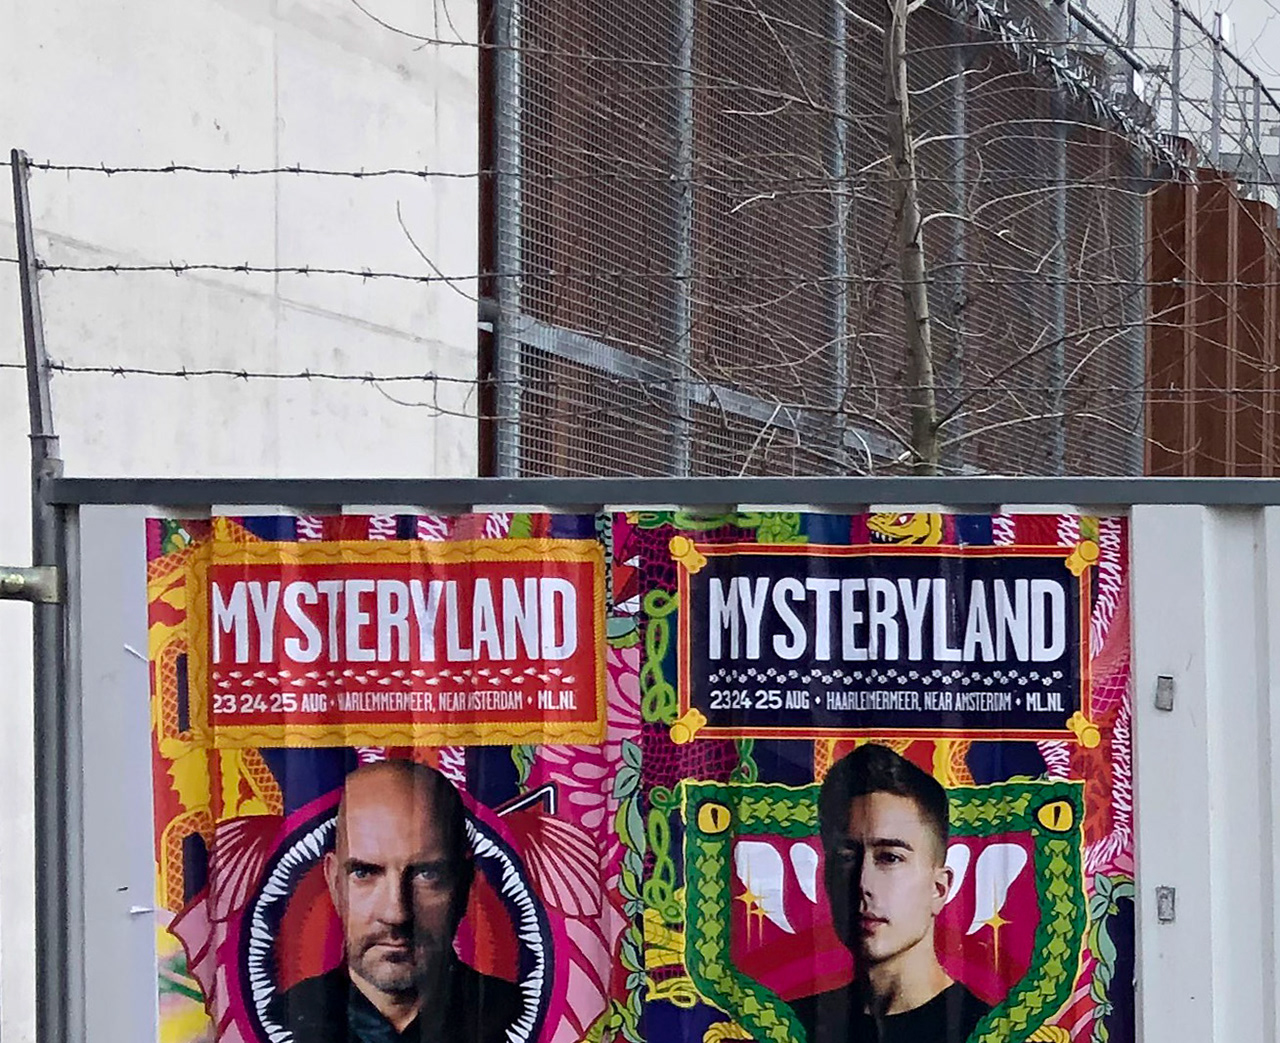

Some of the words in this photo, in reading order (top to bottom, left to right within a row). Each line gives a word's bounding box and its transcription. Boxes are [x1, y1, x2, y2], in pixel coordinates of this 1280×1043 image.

[212, 577, 577, 664] MYSTERYLAND
[709, 577, 1066, 662] MYSTERYLAND
[213, 694, 237, 713] 23
[240, 694, 267, 713] 24
[270, 693, 298, 713] 25
[302, 693, 327, 712] AUG
[439, 691, 466, 711] NEAR
[537, 690, 577, 710] ML.NL
[710, 690, 731, 709] 23
[731, 690, 752, 709] 24
[755, 690, 782, 709] 25
[785, 690, 810, 709] AUG
[924, 692, 952, 711] NEAR
